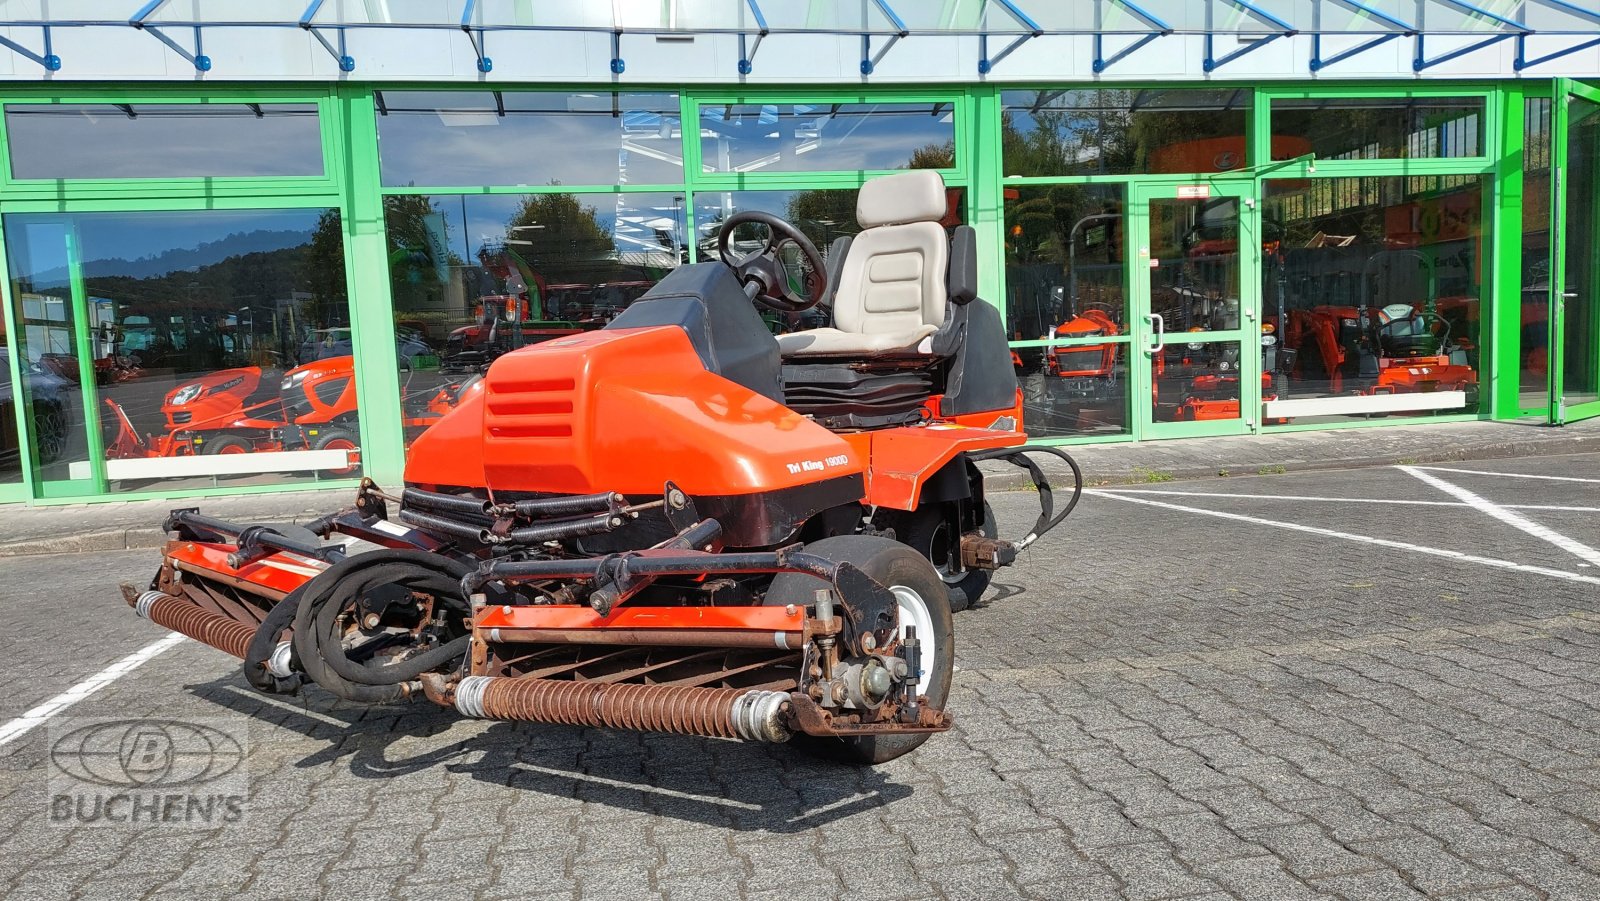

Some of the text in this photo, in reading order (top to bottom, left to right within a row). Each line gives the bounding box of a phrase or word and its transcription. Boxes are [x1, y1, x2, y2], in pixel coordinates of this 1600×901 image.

[786, 454, 848, 474] Tri King 1900D
